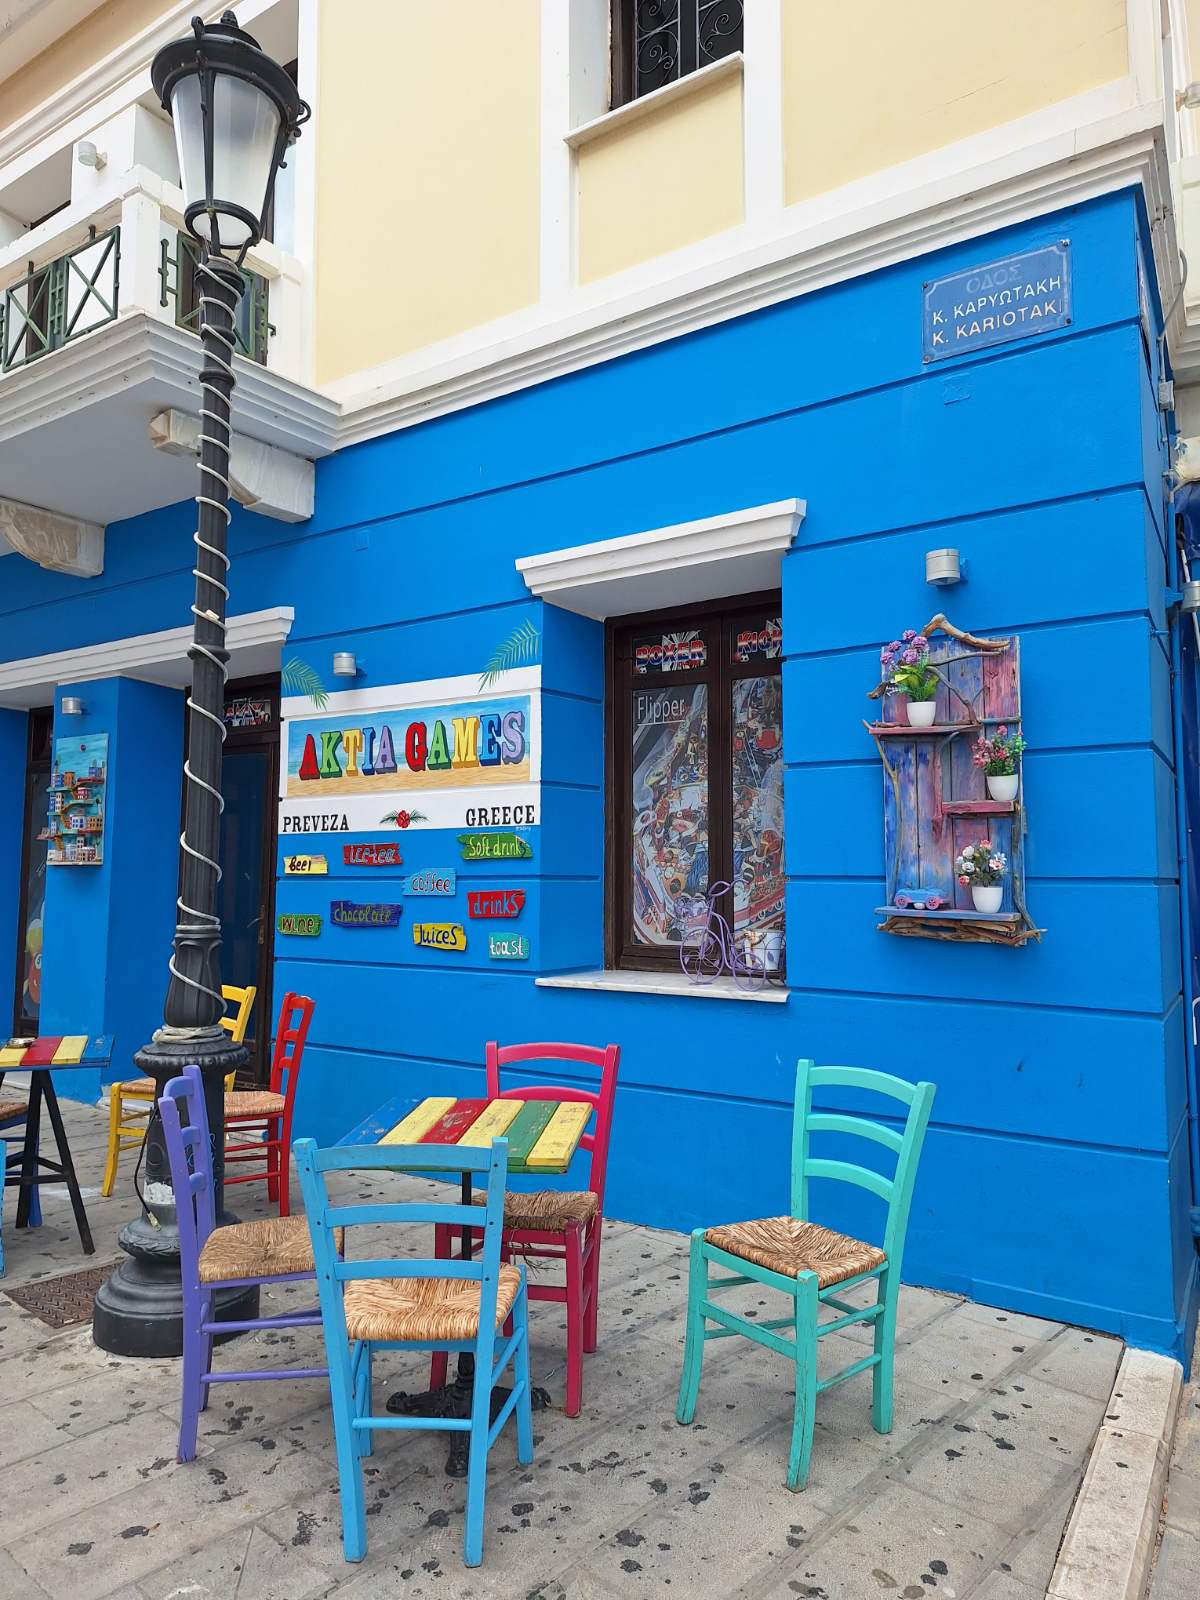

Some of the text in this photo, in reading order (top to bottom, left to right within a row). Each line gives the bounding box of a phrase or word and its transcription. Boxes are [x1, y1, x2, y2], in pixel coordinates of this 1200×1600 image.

[966, 264, 1022, 293] ΟΔΟΣ
[932, 275, 1061, 326] Κ. ΚΑΡΥΩΤΑΚΗ
[932, 299, 1063, 346] K. KARIOTAKI
[636, 640, 704, 667] BOXER
[637, 696, 685, 723] Flipper
[299, 710, 525, 780] AKTIA GAMES
[282, 813, 350, 833] PREVEZA
[465, 804, 535, 827] GREECE
[412, 871, 451, 893] coffee
[333, 902, 393, 924] chocolate
[489, 936, 525, 956] toast
